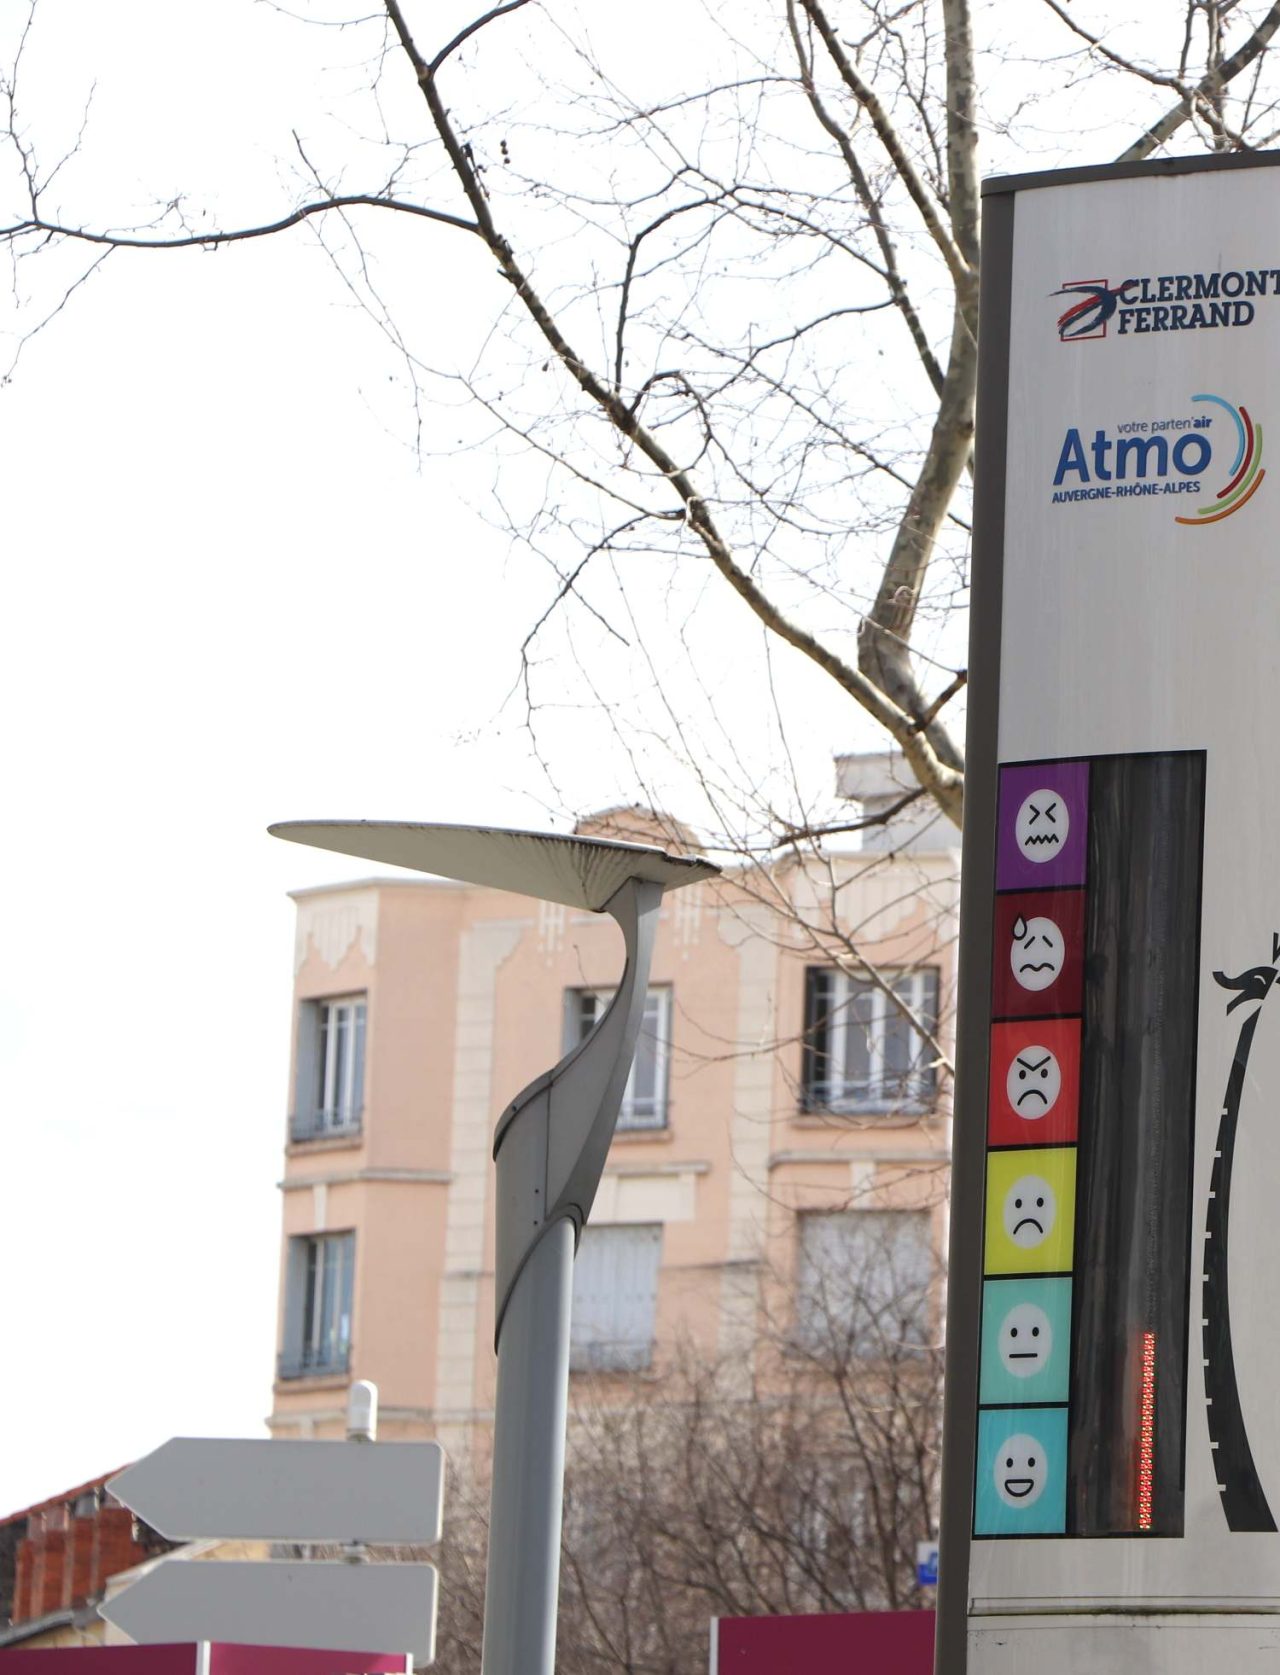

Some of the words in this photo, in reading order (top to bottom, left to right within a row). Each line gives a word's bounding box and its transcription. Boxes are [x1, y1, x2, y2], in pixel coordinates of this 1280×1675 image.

[1117, 301, 1255, 334] FERRAND
[1117, 421, 1148, 433] votre
[1053, 428, 1212, 486] Atmo
[1052, 481, 1200, 503] AUVERGNE-RHÔNE-ALPES
